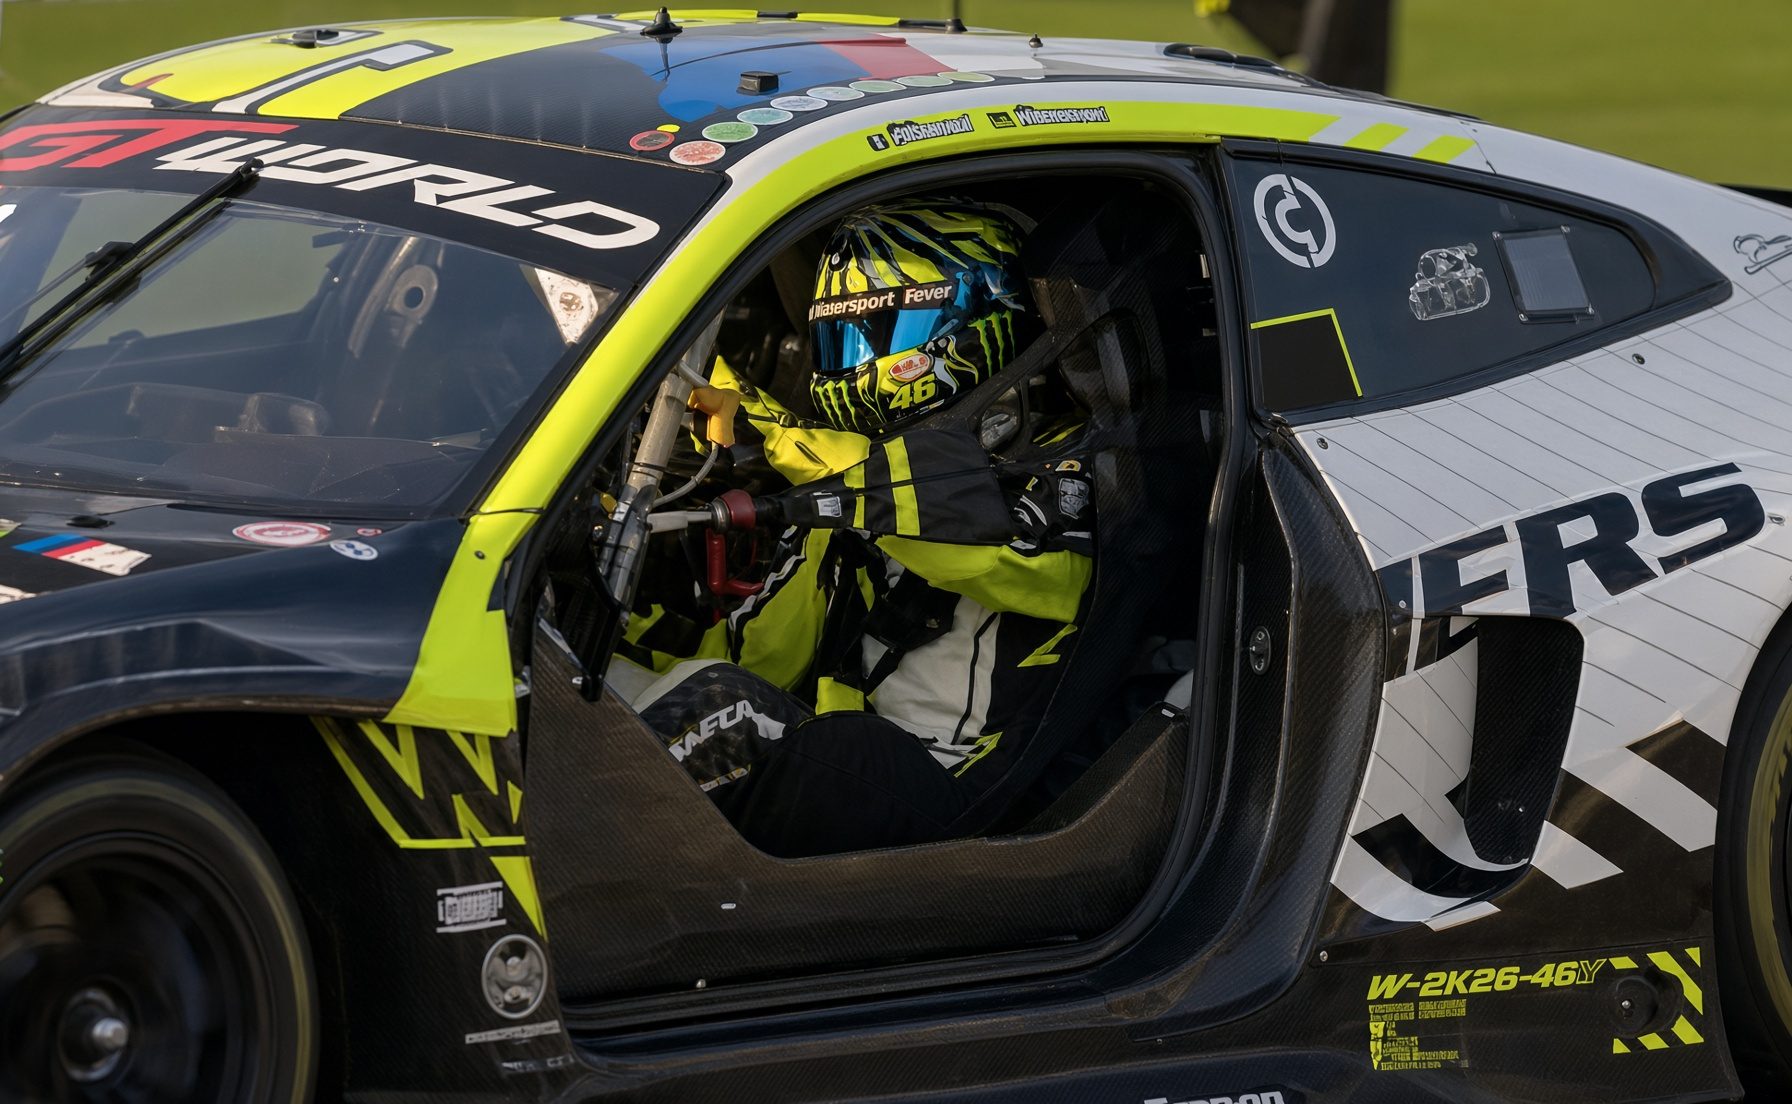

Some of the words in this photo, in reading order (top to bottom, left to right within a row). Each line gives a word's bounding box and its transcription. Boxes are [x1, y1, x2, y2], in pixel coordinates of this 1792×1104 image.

[0, 118, 300, 172] GT
[154, 136, 661, 250] WORLD
[904, 285, 953, 305] Fever
[888, 373, 937, 411] 46
[1367, 959, 1607, 1000] W-2K26-46Y
